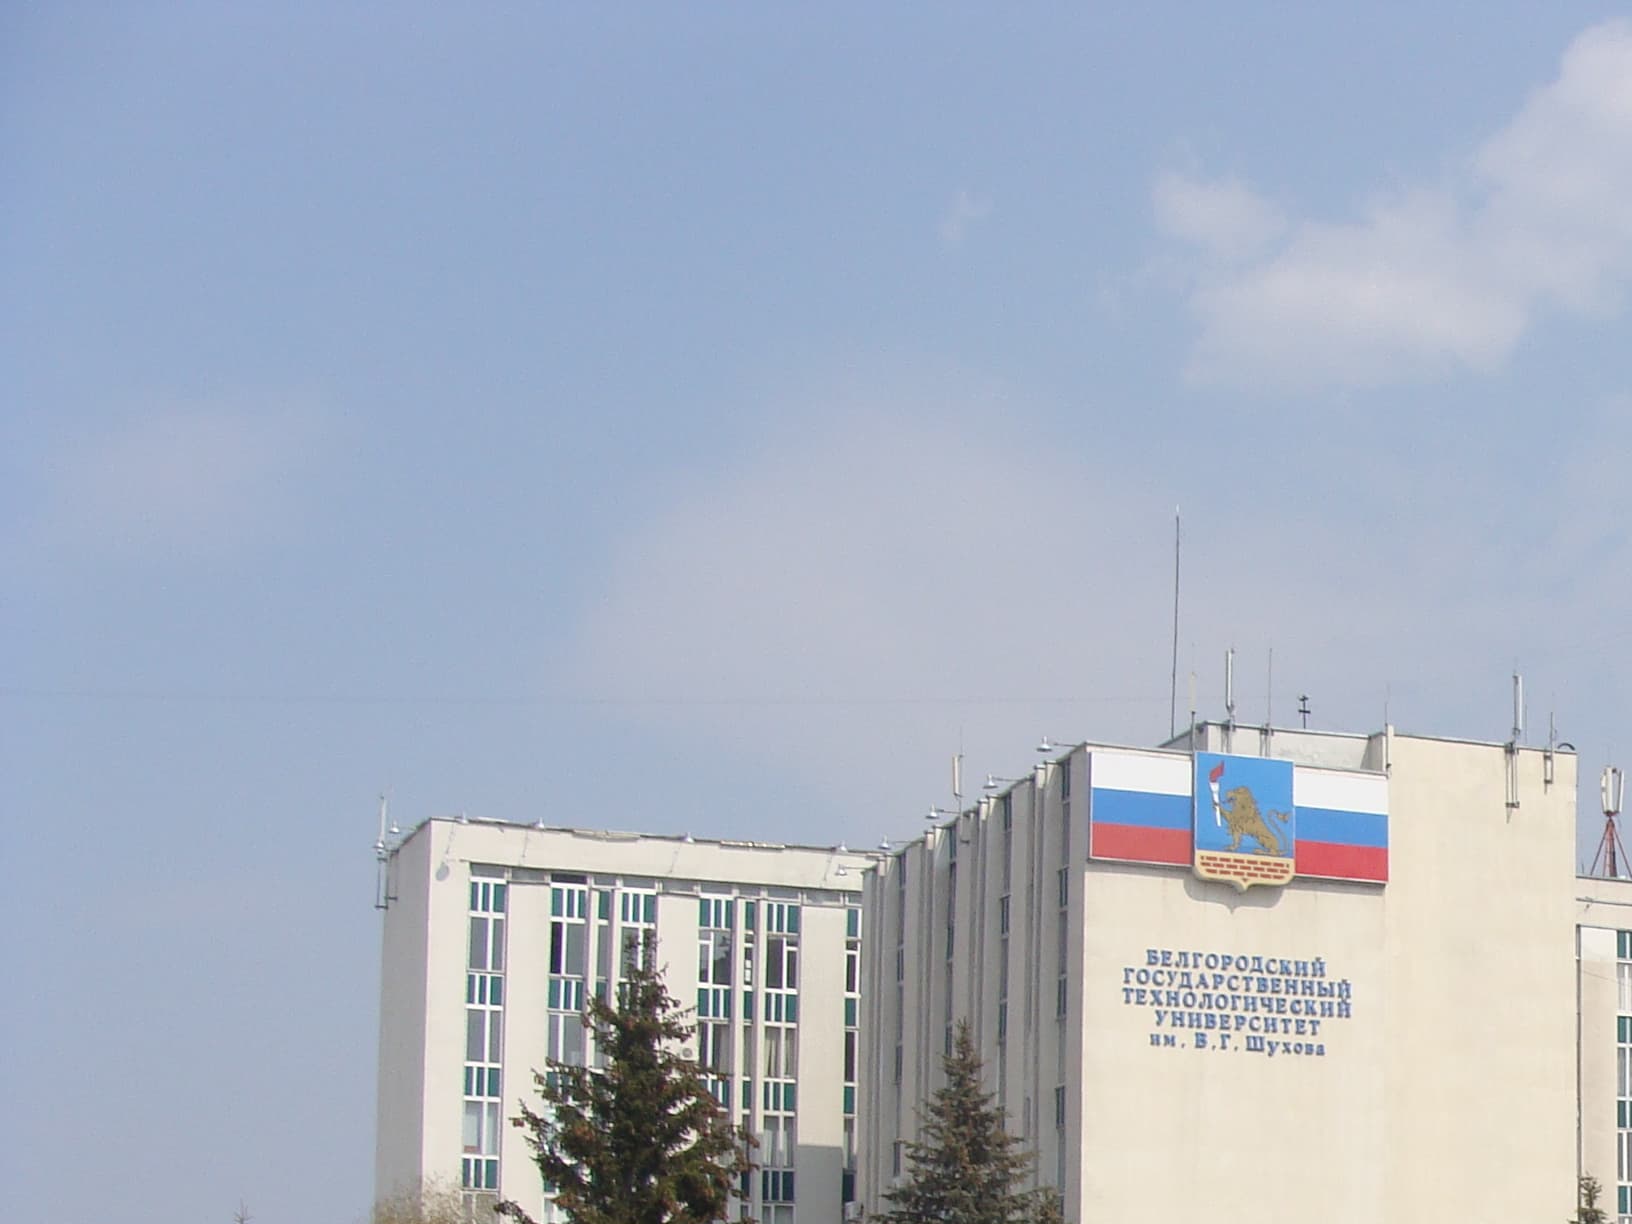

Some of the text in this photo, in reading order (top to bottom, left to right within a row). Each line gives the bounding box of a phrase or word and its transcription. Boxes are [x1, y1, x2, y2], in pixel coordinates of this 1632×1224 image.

[1146, 949, 1326, 978] БЕЛГОРОДСКИЙ
[1123, 967, 1352, 999] ГОСУДАРСТВЕННЫЙ
[1122, 987, 1352, 1018] ТЕХНОЛОГИЧЕСКИЙ
[1155, 1010, 1321, 1036] УНИВЕРСИТЕТ
[1149, 1033, 1186, 1049] им.
[1245, 1035, 1326, 1057] Шухова
